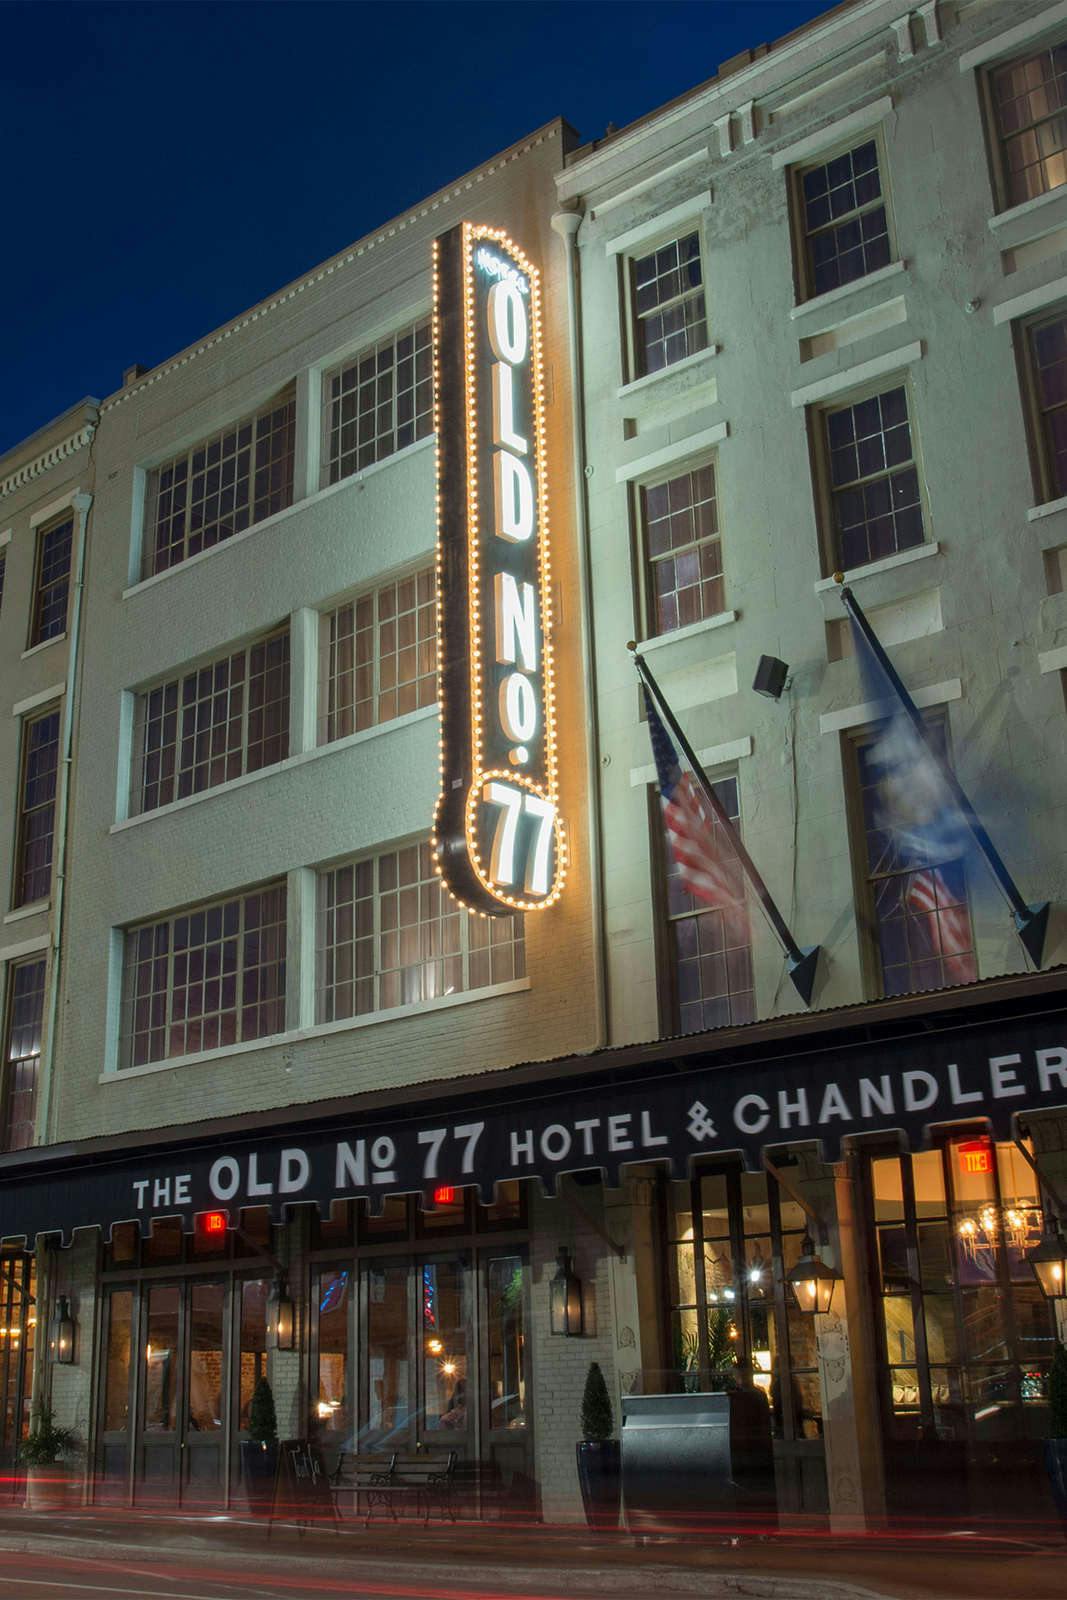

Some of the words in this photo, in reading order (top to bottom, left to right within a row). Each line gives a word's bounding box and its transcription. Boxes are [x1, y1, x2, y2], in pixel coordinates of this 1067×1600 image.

[488, 279, 533, 540] OLD
[483, 782, 555, 895] 77
[133, 1174, 191, 1209] THE
[209, 1149, 309, 1200] OLD
[417, 1122, 485, 1179] 77
[510, 1111, 667, 1166] HOTEL
[685, 1101, 717, 1142] &
[734, 1047, 1067, 1134] CHANDLER
